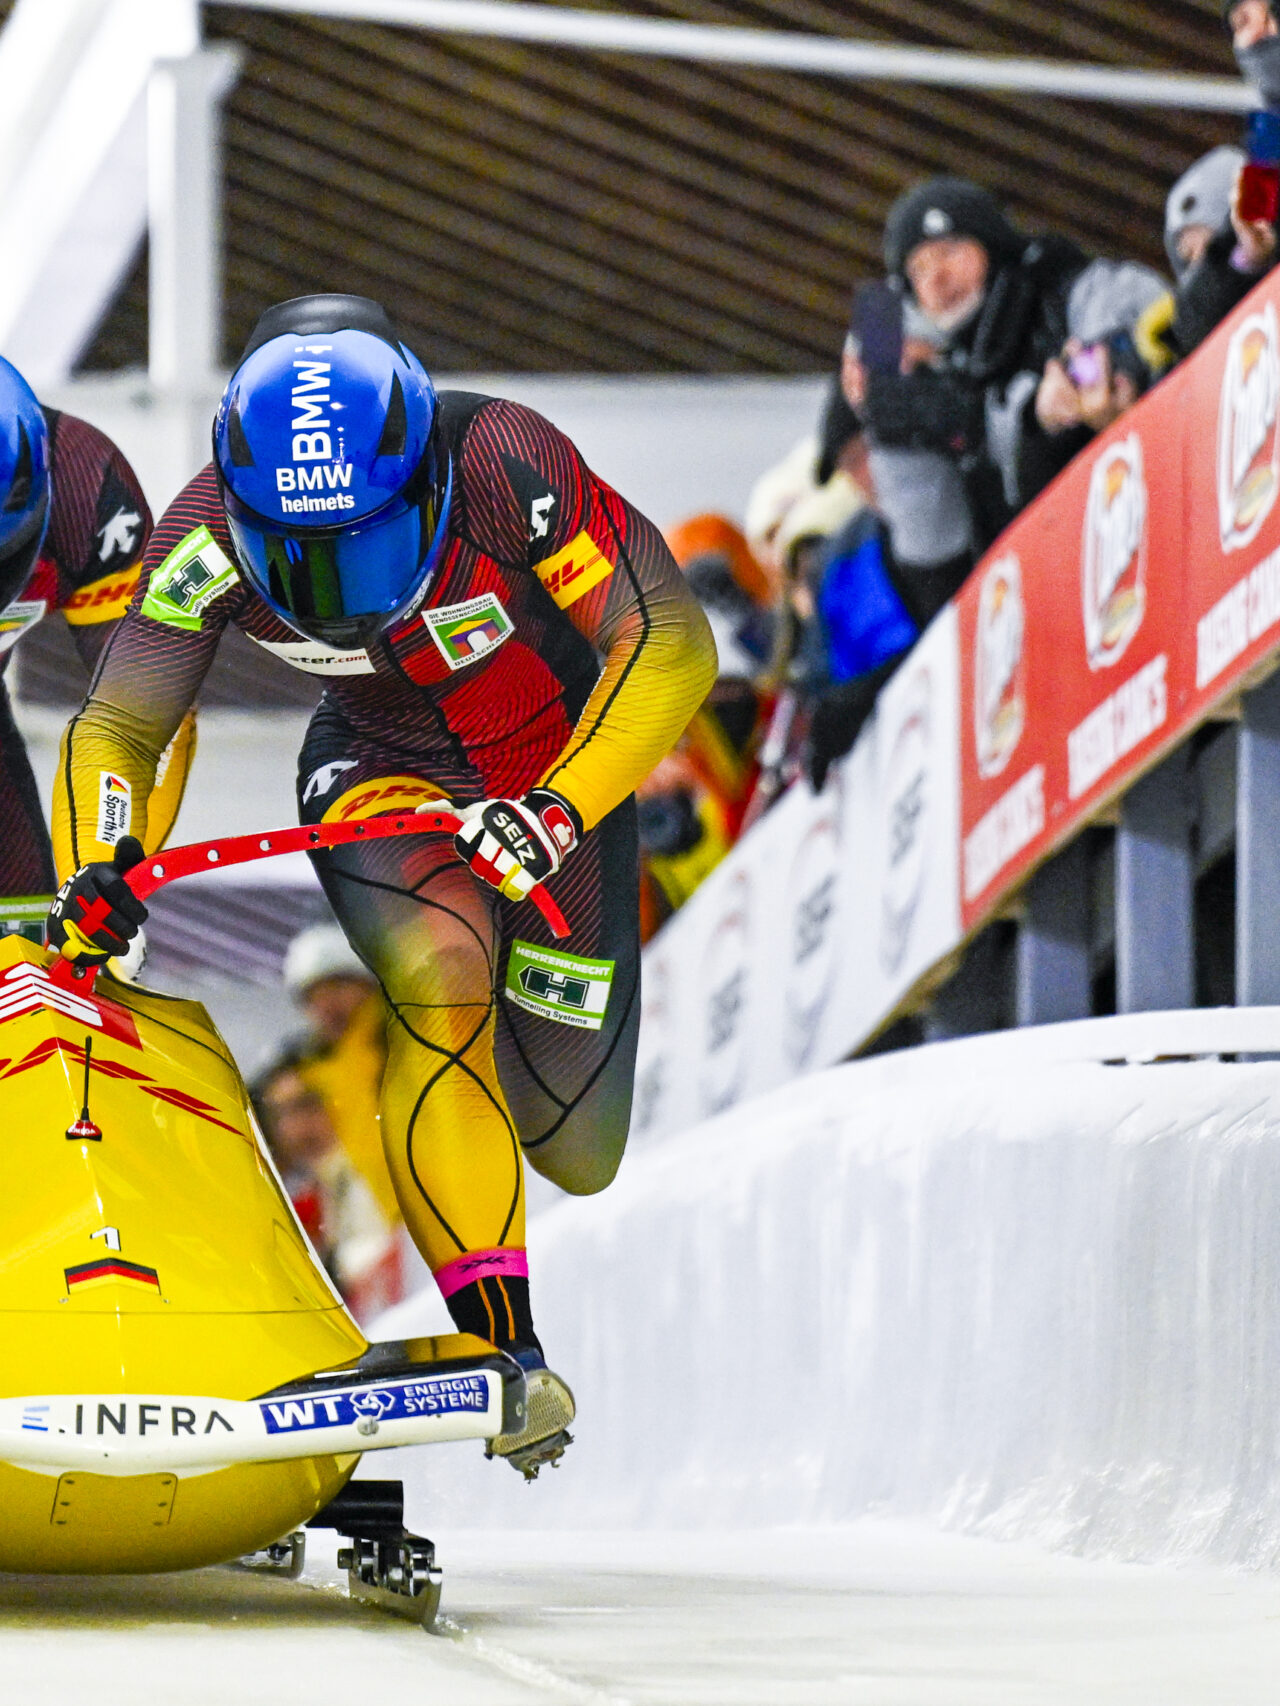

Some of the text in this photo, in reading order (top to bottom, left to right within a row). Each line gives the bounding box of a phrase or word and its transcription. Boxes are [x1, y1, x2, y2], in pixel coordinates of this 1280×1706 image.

[291, 361, 333, 461] BMW
[276, 463, 353, 491] BMW
[281, 493, 355, 513] helmets
[431, 601, 494, 625] GENOSSENSCHAFTEN
[454, 629, 511, 666] DEUTSCHLAND
[516, 946, 610, 976] HERRENKNECHT
[513, 994, 588, 1025] Tunnelling Systems
[90, 1226, 122, 1252] 1
[268, 1378, 481, 1429] WT ENERGIE
[403, 1391, 484, 1413] SYSTEME
